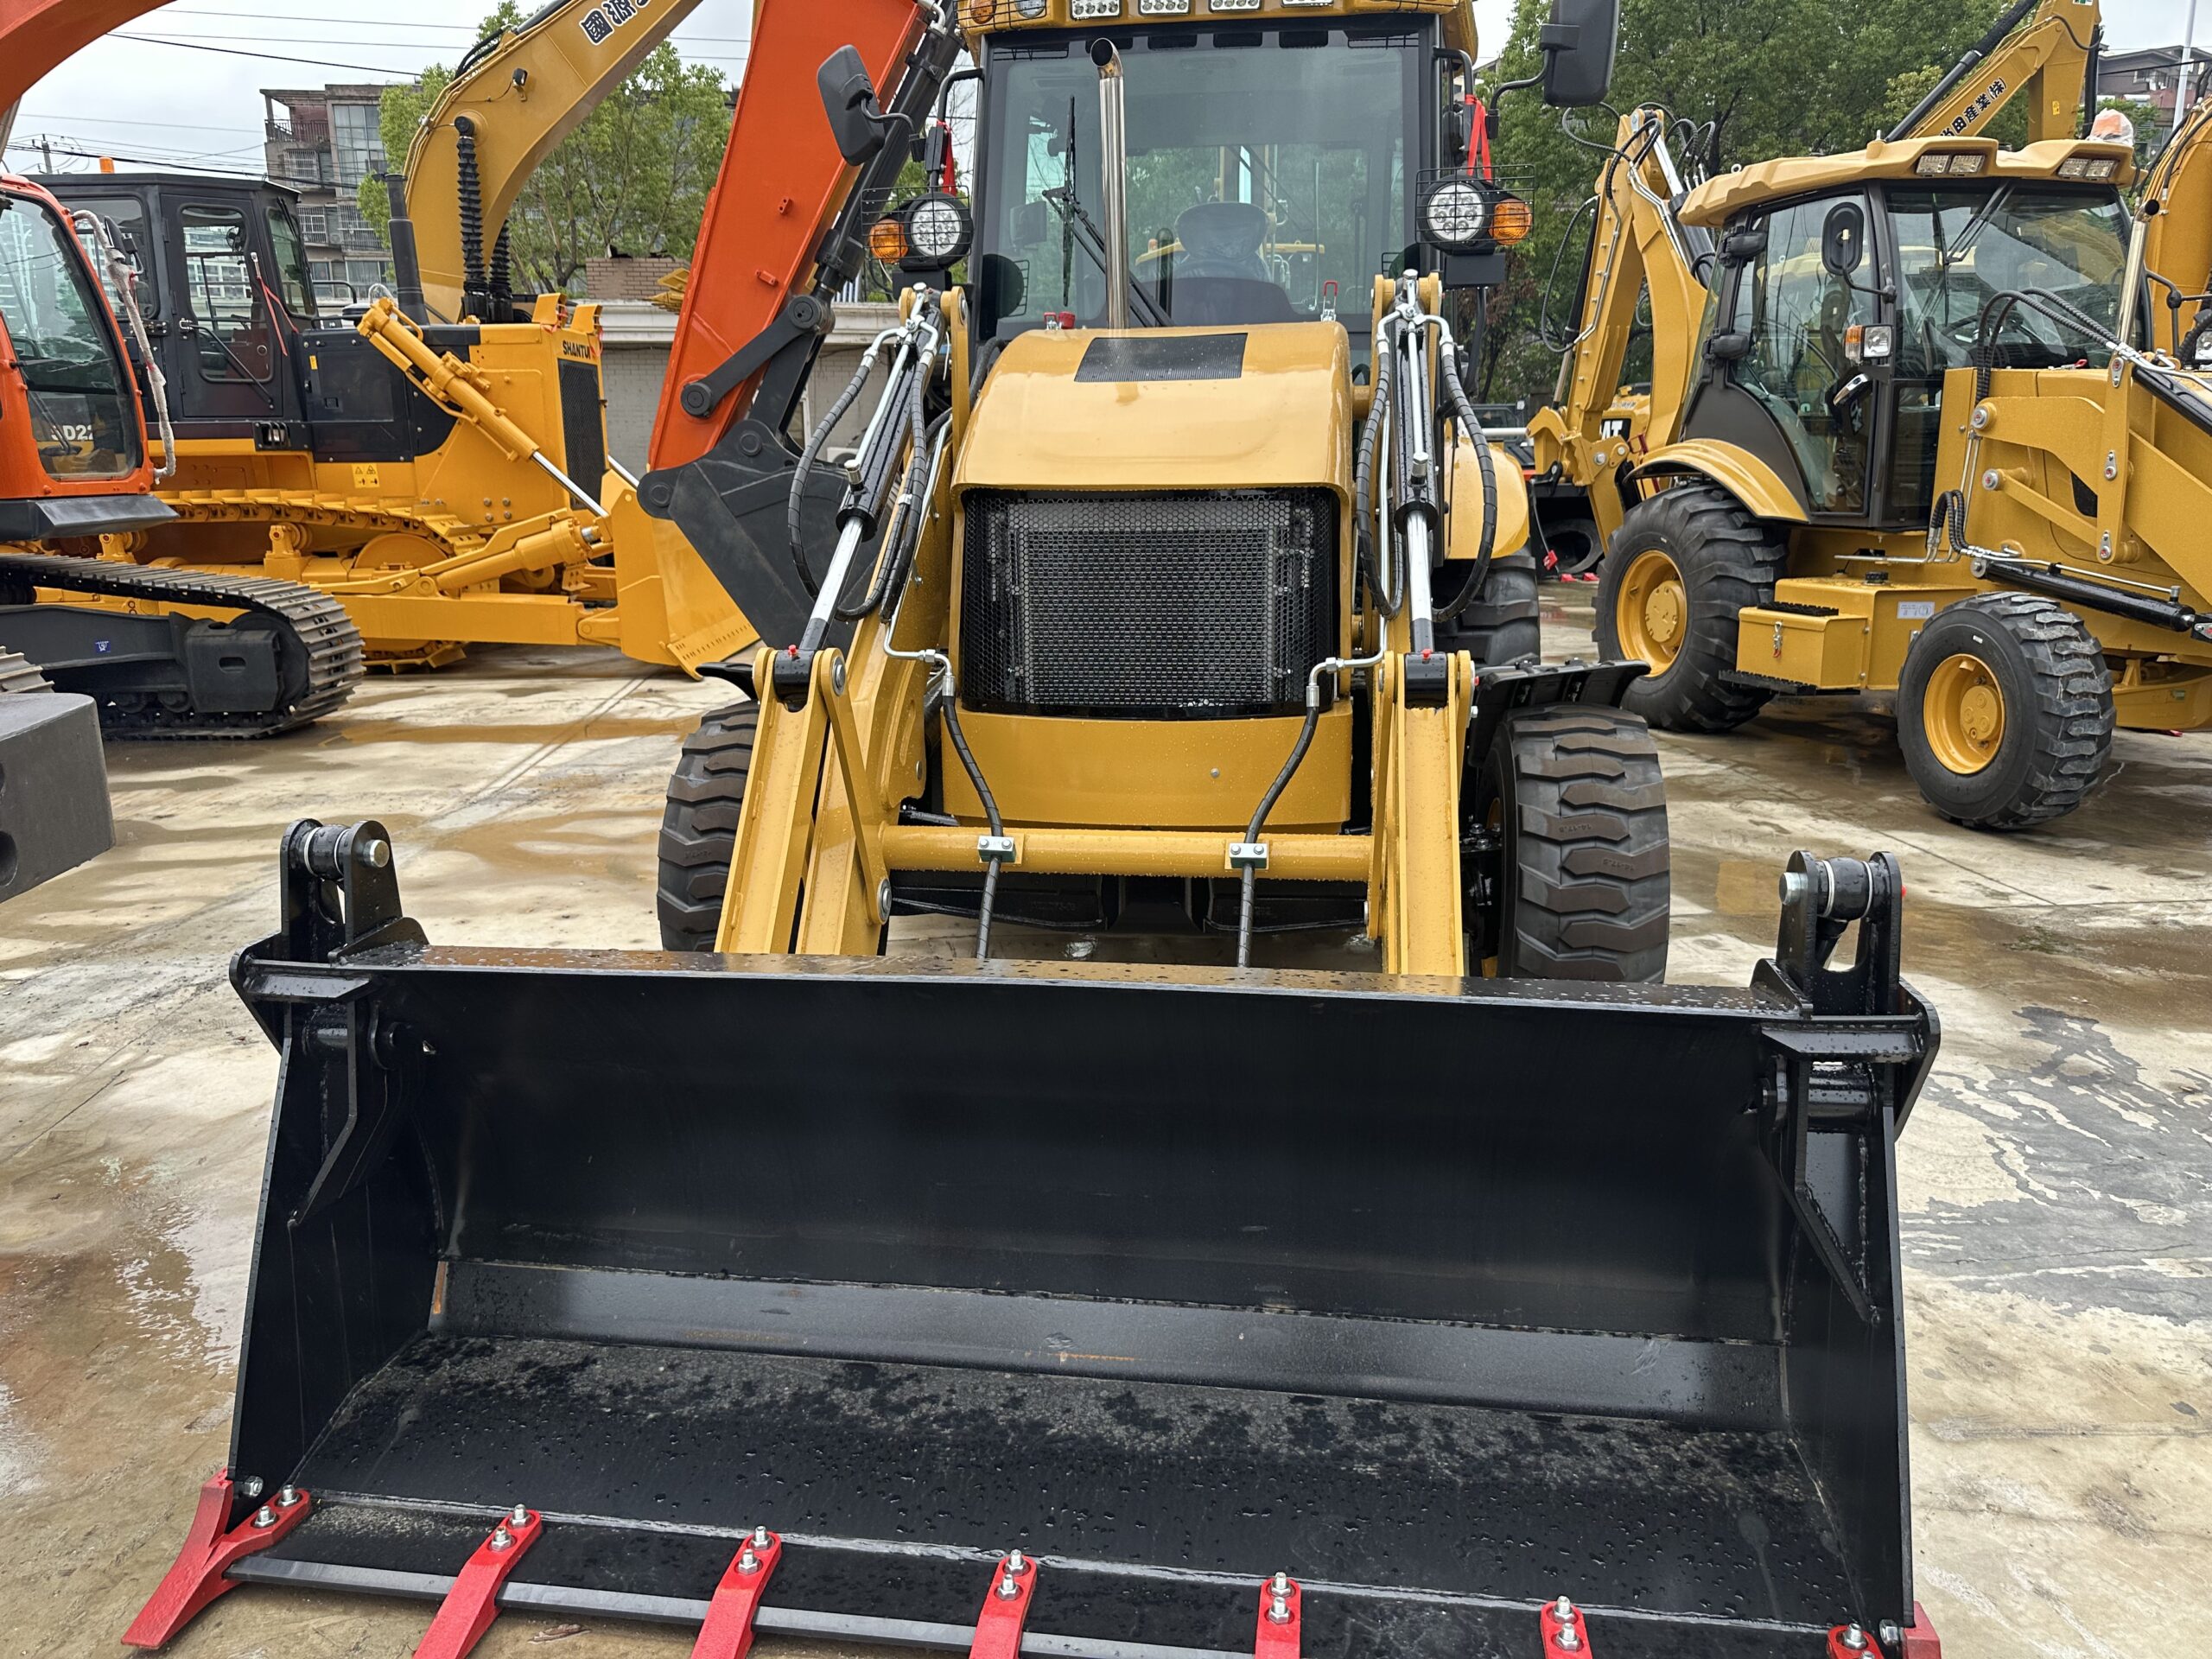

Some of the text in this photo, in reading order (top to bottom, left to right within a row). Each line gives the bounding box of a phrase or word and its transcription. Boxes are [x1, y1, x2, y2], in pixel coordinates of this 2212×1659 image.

[580, 0, 650, 44] 國源
[563, 340, 591, 359] SHANTUI
[1601, 420, 1623, 441] AT
